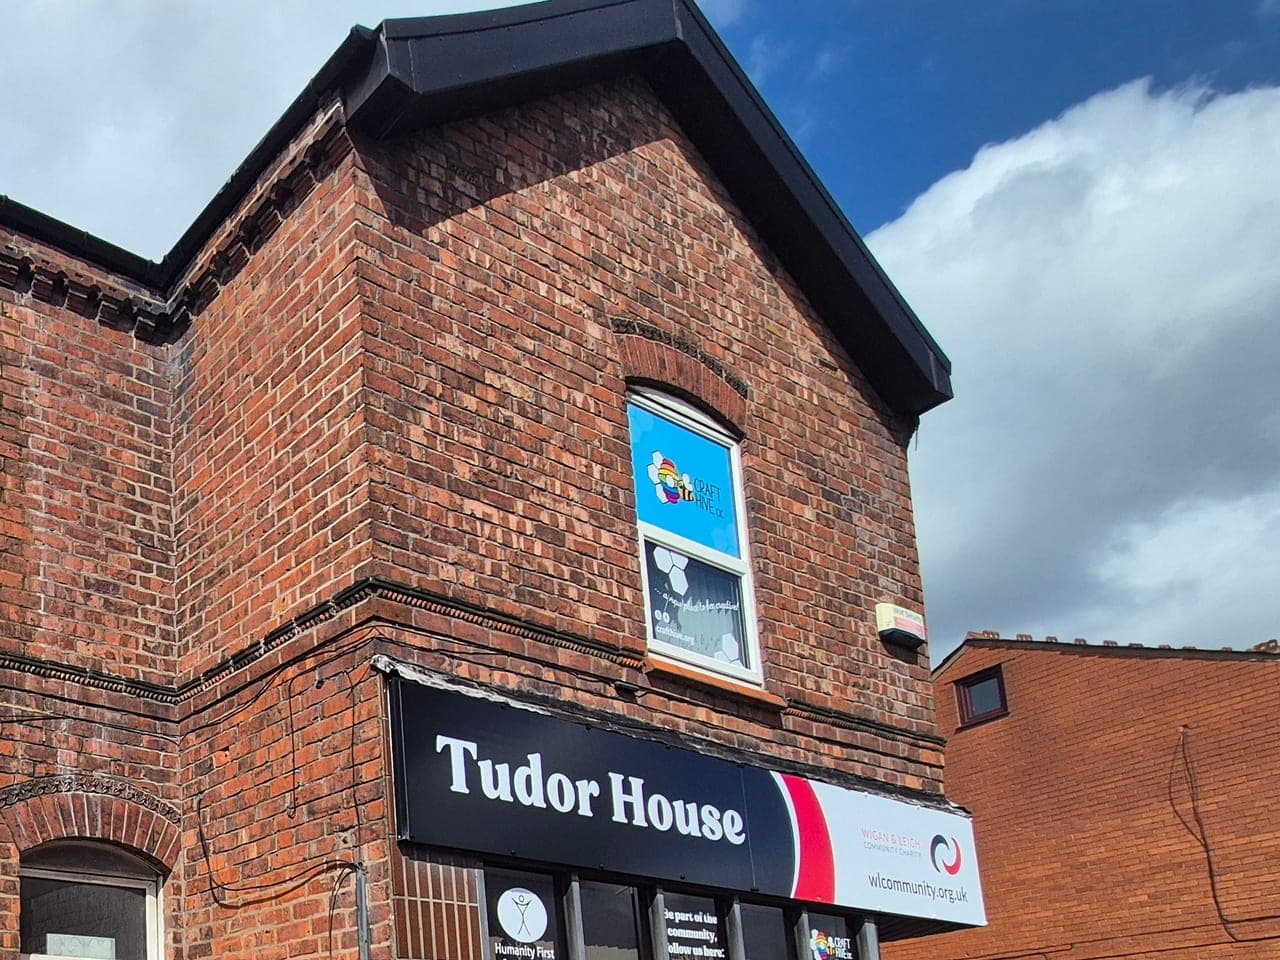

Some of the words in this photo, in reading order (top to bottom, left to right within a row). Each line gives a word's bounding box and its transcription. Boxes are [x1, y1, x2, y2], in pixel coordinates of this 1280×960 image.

[694, 478, 720, 501] CRAFT
[695, 492, 716, 514] HIVE
[436, 734, 600, 817] Tudor
[608, 771, 746, 845] House
[862, 828, 888, 843] WIGAN
[899, 835, 920, 849] LEIGH
[868, 872, 968, 904] wlcommunity.org.uk
[675, 912, 694, 923] part
[703, 912, 718, 924] the
[667, 928, 718, 943] community,
[495, 942, 535, 960] Humanity
[536, 946, 555, 960] First
[667, 942, 692, 955] ollow
